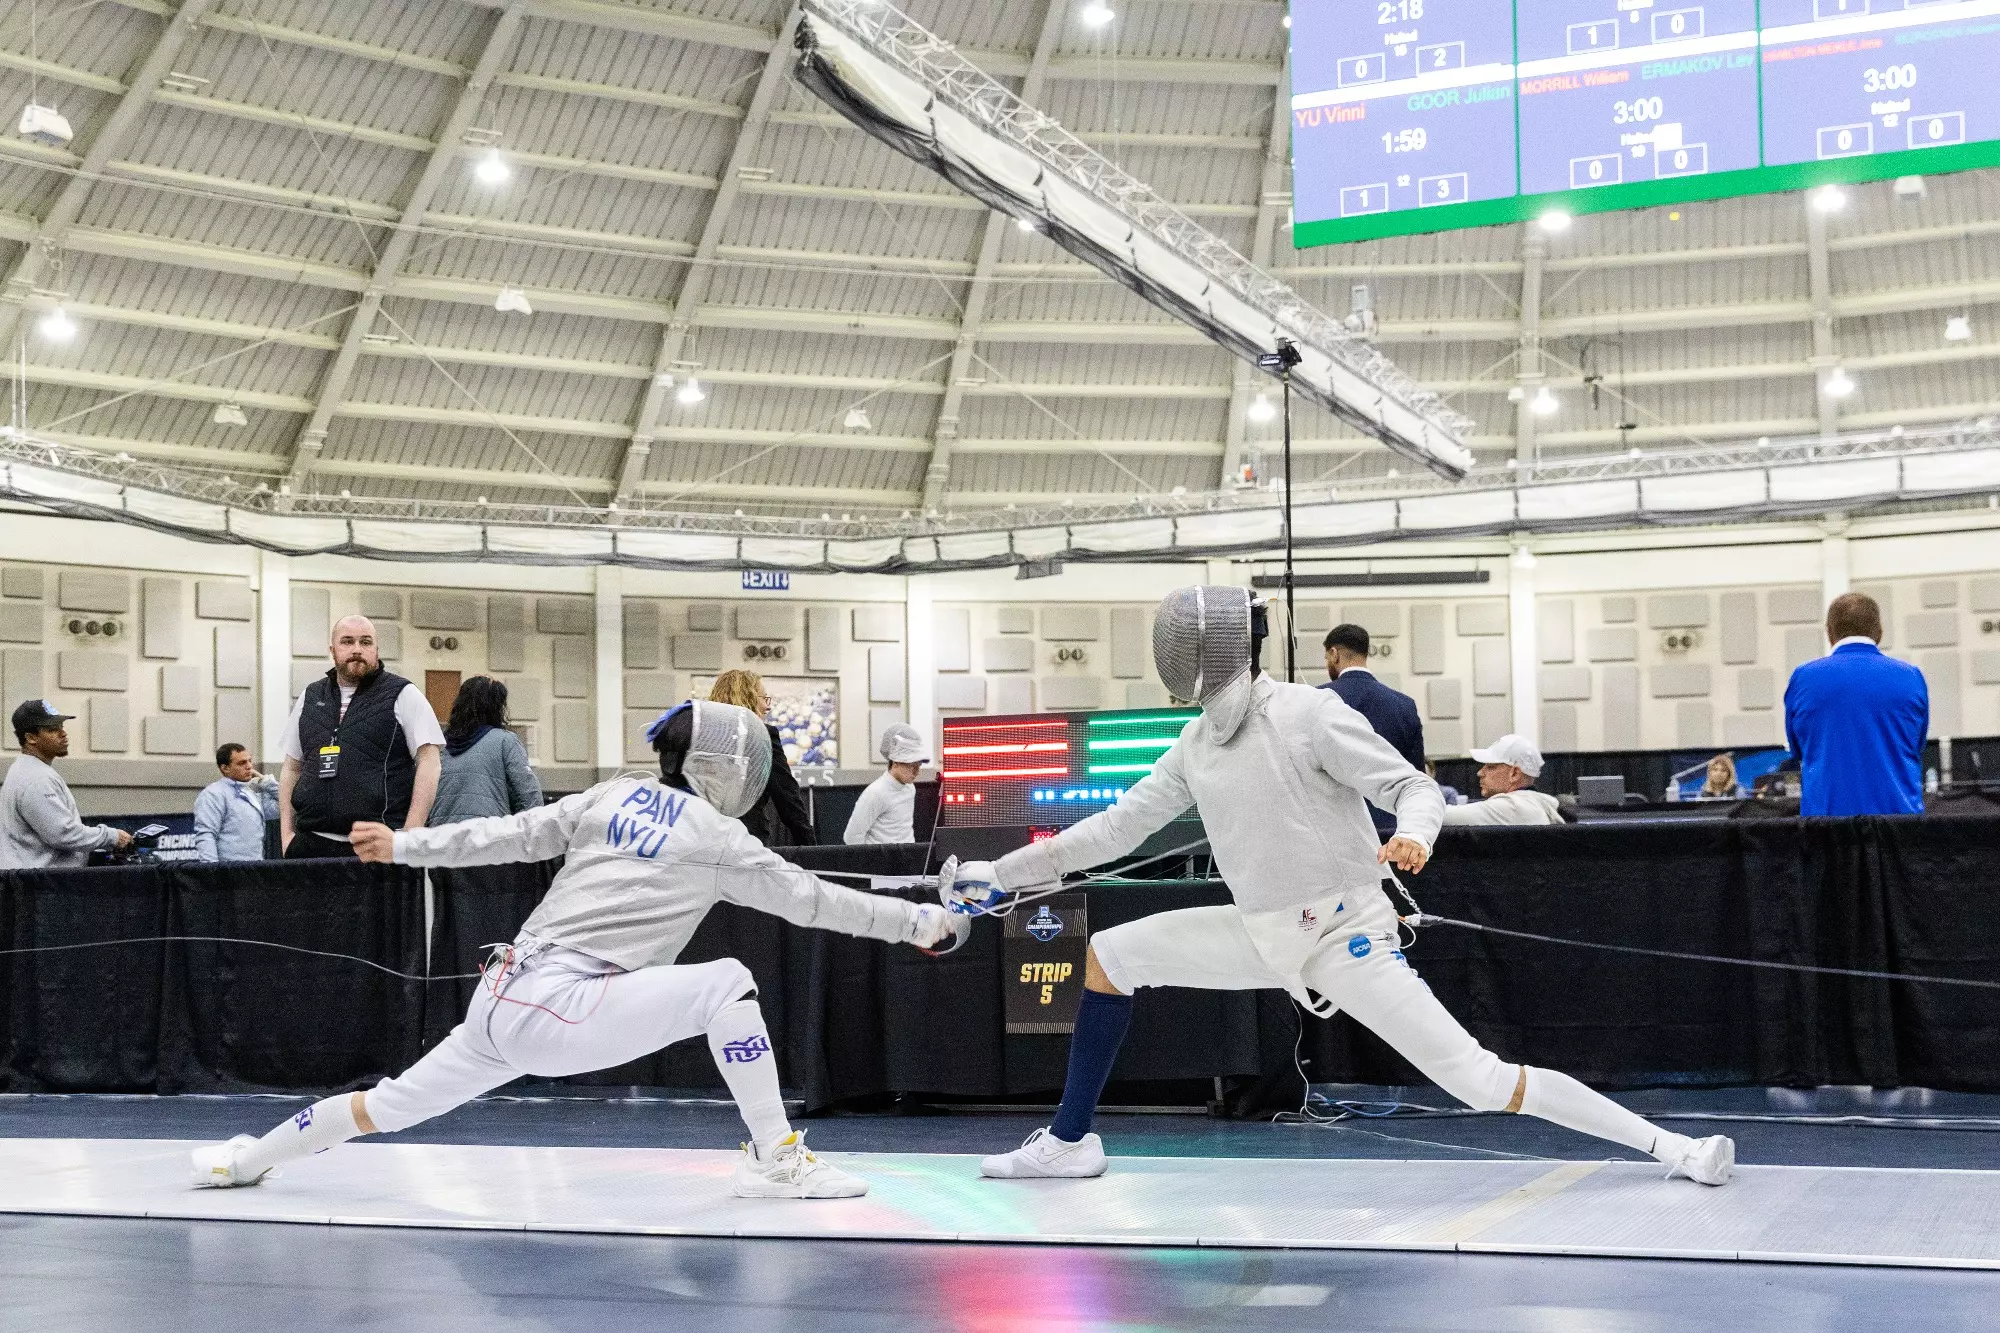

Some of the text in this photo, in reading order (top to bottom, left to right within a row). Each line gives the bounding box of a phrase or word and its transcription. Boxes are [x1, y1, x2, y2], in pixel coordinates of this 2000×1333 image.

[1378, 0, 1423, 24] 2:18
[1671, 13, 1684, 34] 0
[1587, 25, 1598, 45] 1
[1433, 48, 1446, 67] 2
[1355, 60, 1367, 78] 0
[1641, 56, 1723, 80] ERMAKOV
[1863, 64, 1917, 92] 3:00
[1519, 76, 1581, 95] MORRILL
[1407, 92, 1459, 111] GOOR
[1613, 96, 1663, 124] 3:00
[1296, 103, 1366, 128] YU Vinni
[1929, 118, 1944, 139] 0
[1382, 128, 1426, 153] 1:59
[1838, 130, 1852, 150] 0
[1589, 160, 1602, 179] 0
[1674, 150, 1687, 169] 0
[1360, 190, 1368, 207] 1
[1437, 180, 1449, 198] 3
[750, 571, 780, 587] EXIT
[621, 786, 688, 827] PAN
[606, 813, 668, 858] NYU
[1020, 963, 1072, 983] STRIP
[1040, 985, 1053, 1004] 5
